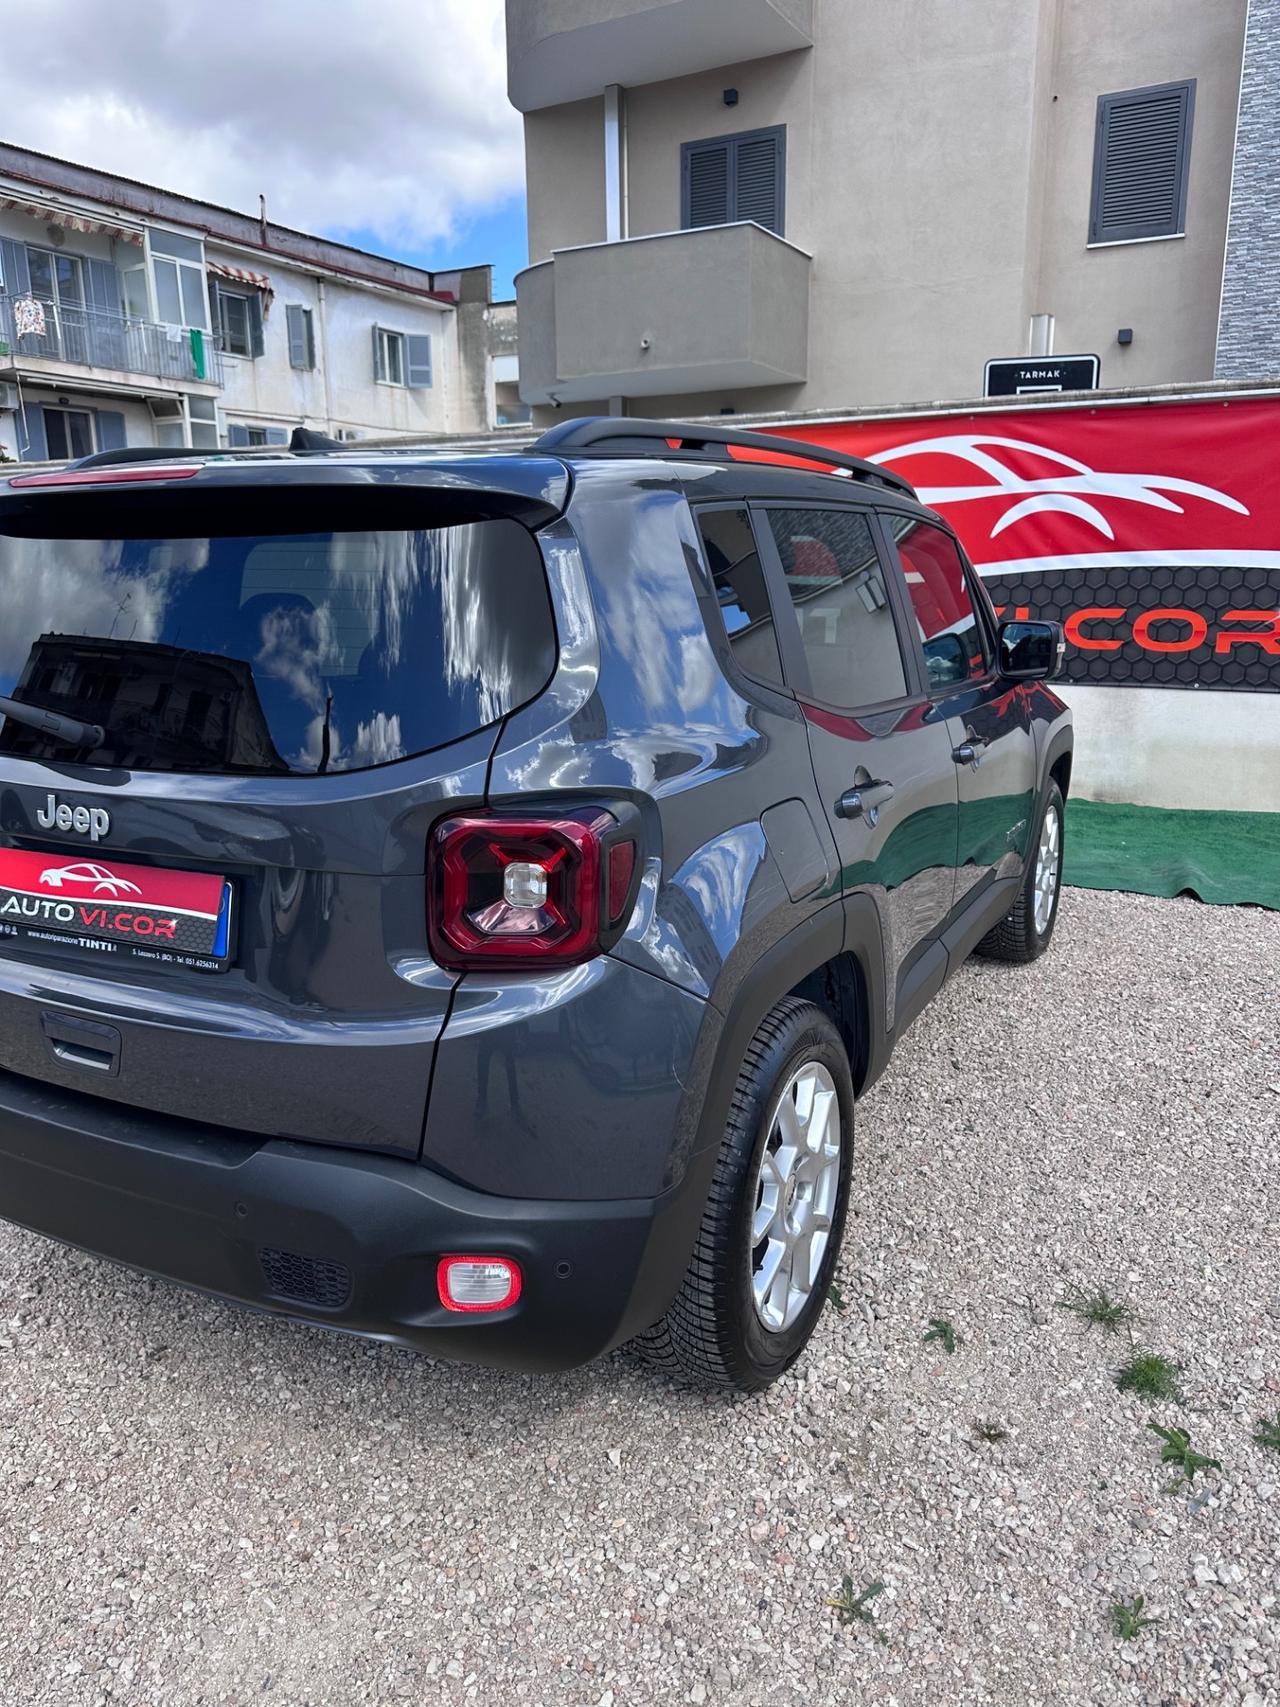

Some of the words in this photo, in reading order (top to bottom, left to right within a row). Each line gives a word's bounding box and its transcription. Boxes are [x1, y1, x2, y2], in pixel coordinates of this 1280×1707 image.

[1020, 370, 1060, 379] TARMAK
[36, 794, 111, 842] Jeep
[0, 895, 75, 922] AUTO
[79, 906, 177, 939] VI.COR
